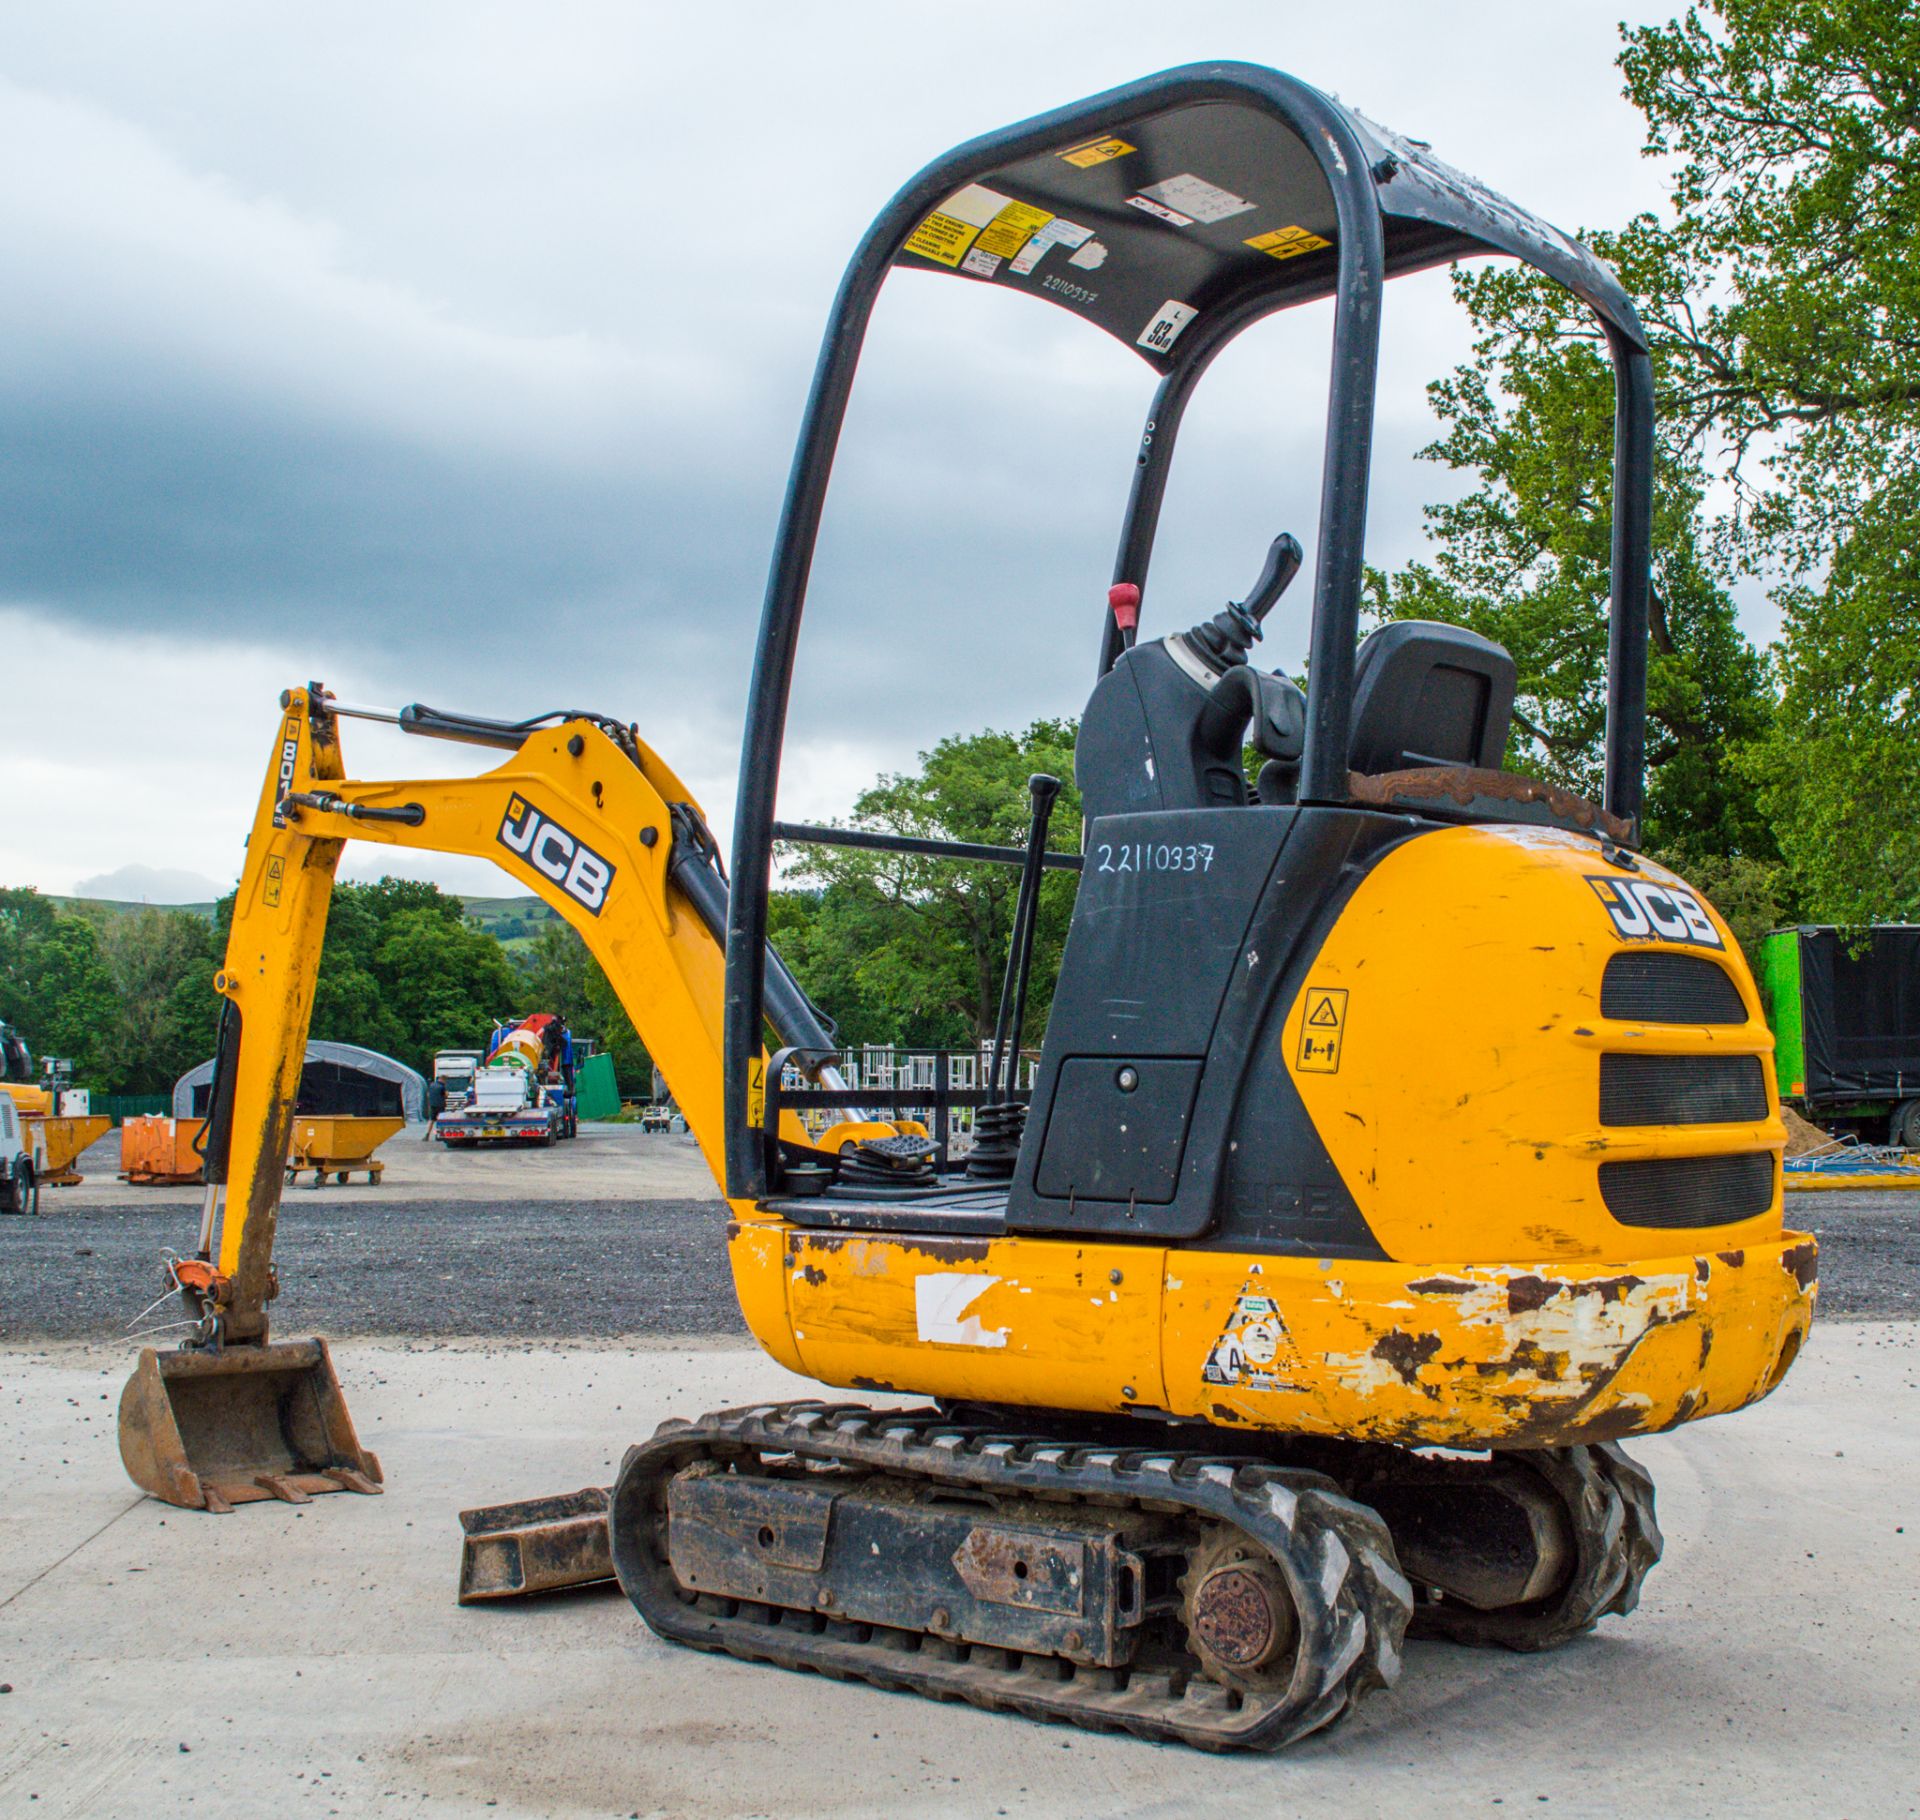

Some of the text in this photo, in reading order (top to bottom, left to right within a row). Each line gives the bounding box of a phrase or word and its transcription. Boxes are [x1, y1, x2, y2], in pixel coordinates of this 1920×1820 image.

[1042, 274, 1098, 304] 22110337
[502, 811, 609, 909] JCB
[1098, 843, 1214, 872] 22110337
[1609, 881, 1721, 944] JCB
